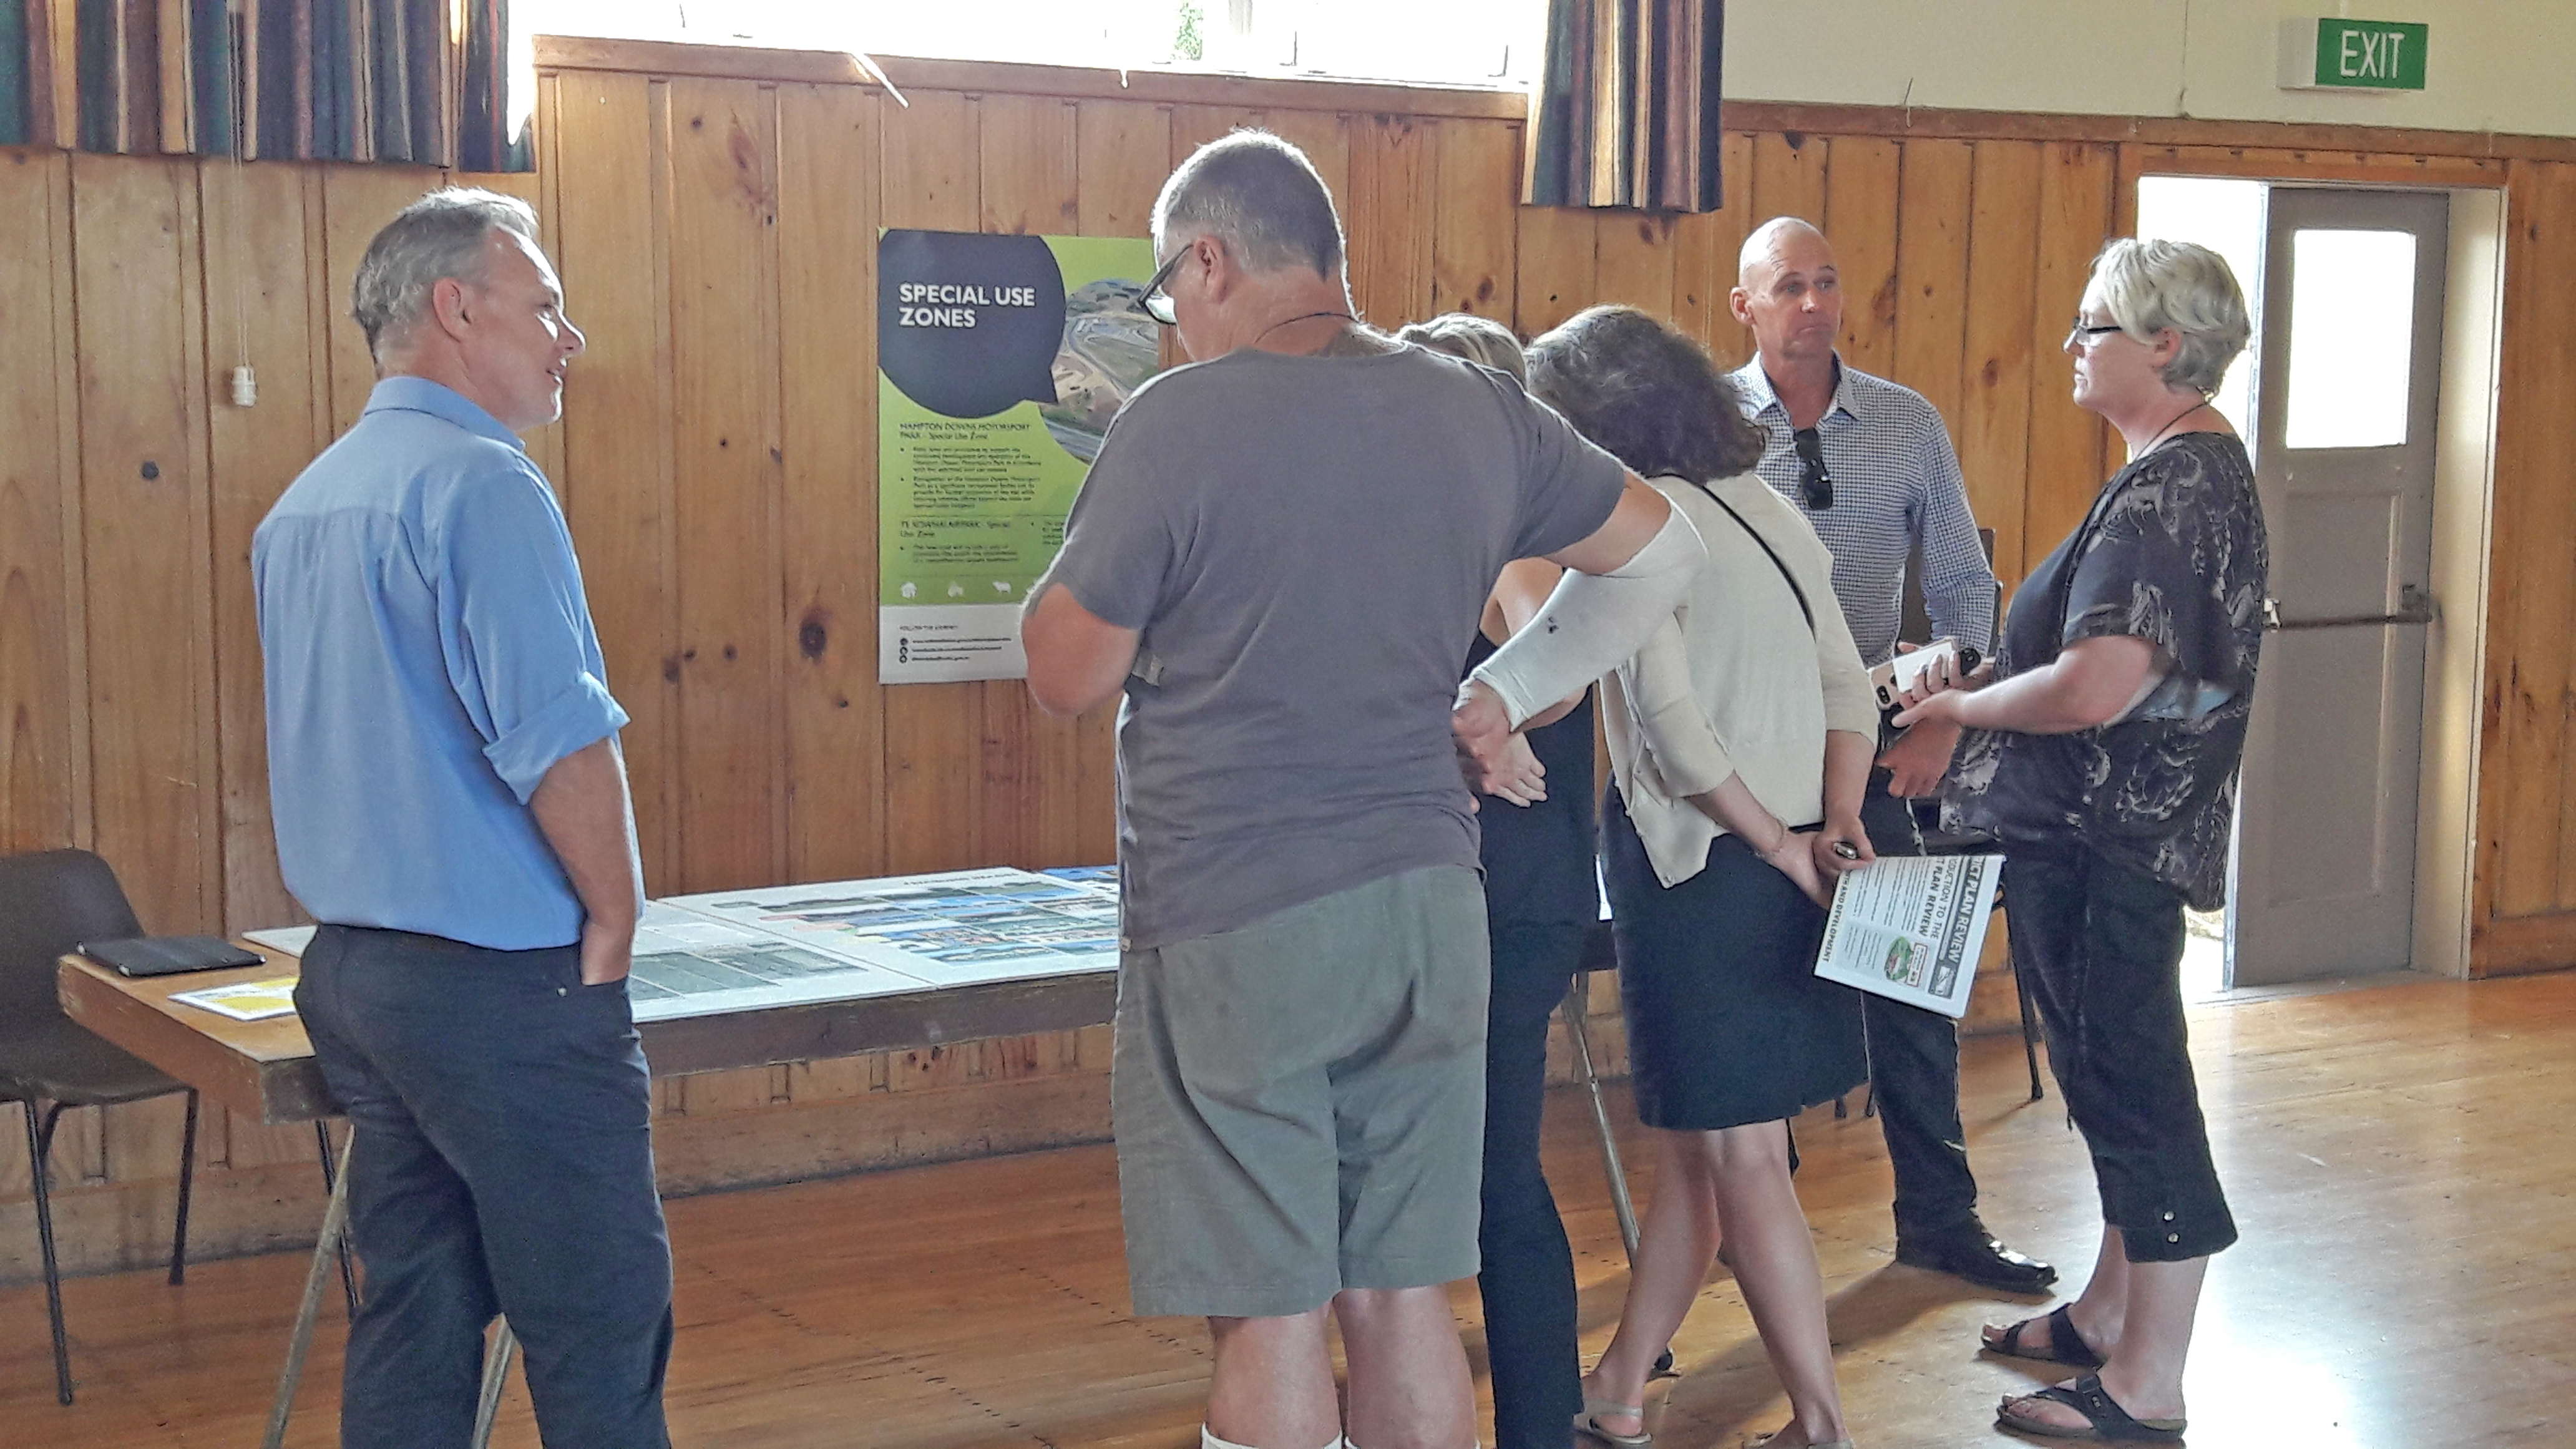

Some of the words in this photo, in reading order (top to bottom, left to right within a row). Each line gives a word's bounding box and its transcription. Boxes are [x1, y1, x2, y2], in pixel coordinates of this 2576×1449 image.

[2341, 30, 2405, 79] EXIT
[899, 283, 991, 305] SPECIAL
[994, 286, 1036, 307] USE
[899, 306, 977, 328] ZONES
[1930, 866, 1944, 891] PLAN
[1936, 905, 1947, 918] TO
[1961, 880, 1979, 915] PLAN
[1919, 894, 1936, 937] REVIEW
[1930, 922, 1943, 939] THE
[1822, 904, 1843, 963] DEVELOPMENT
[1948, 915, 1969, 964] REVIEW
